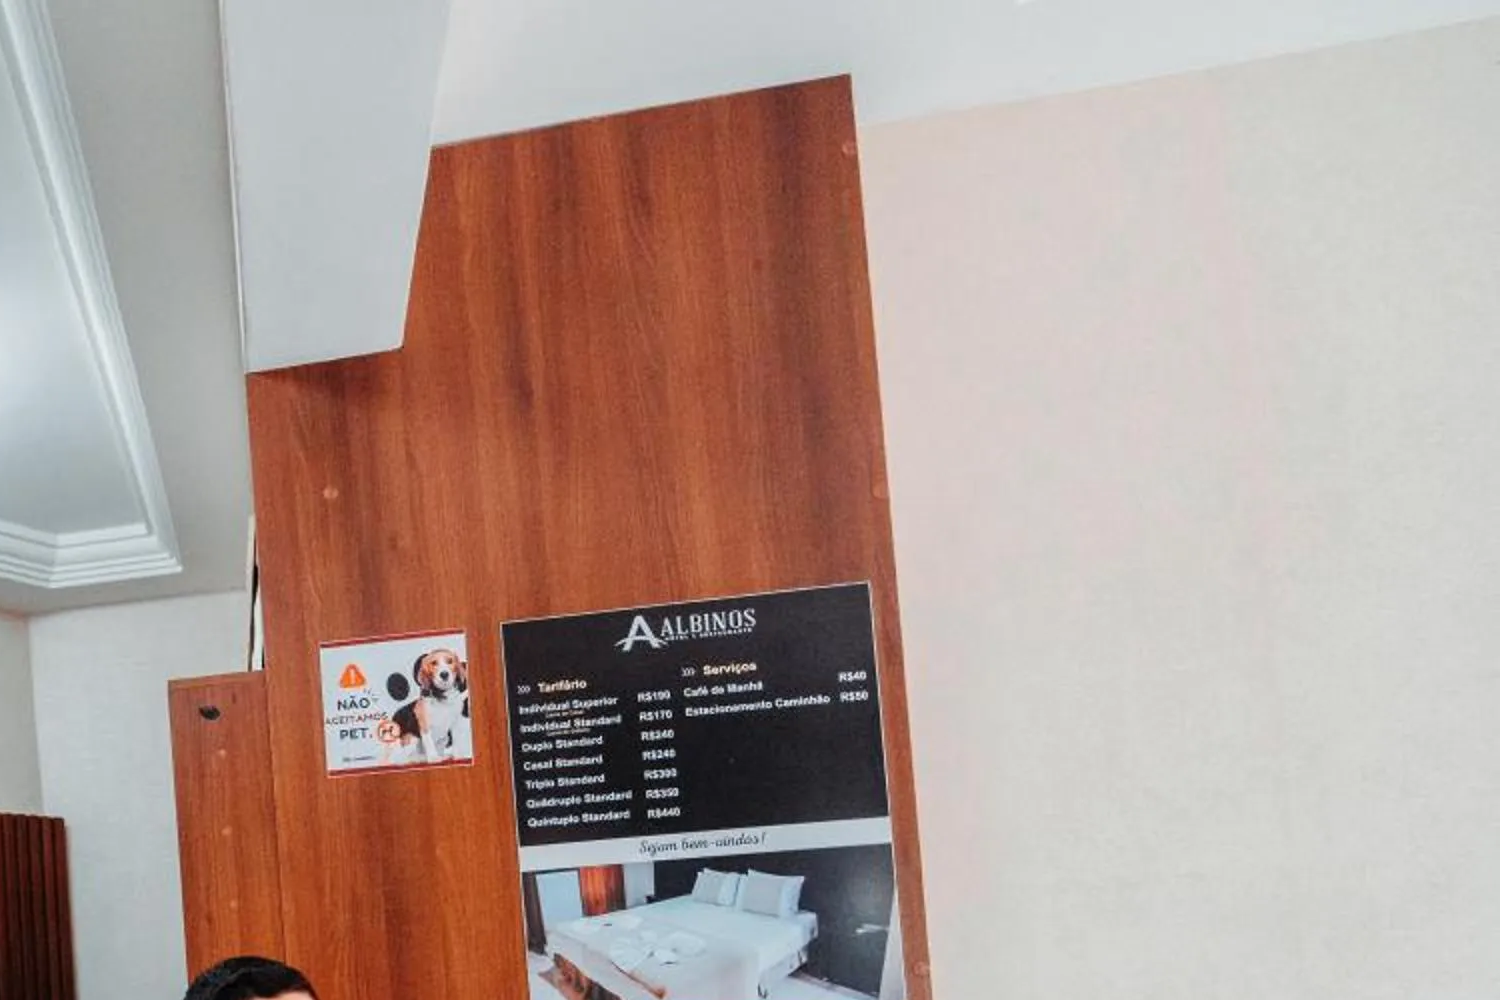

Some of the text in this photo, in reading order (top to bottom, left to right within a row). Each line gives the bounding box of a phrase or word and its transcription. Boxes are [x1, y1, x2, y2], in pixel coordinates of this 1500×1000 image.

[660, 607, 757, 637] ALBINOS
[702, 661, 758, 676] Serviços
[538, 679, 587, 693] Tarifário
[683, 684, 709, 698] Café
[838, 670, 867, 683] R$40
[337, 695, 372, 711] NÃO
[518, 700, 571, 715] Individual
[572, 696, 619, 711] Superior
[685, 700, 773, 717] Estacionamento
[775, 693, 831, 708] Caminhão
[326, 711, 389, 726] ACEITAMOS
[519, 718, 572, 734] Individual
[573, 713, 623, 728] Standard
[639, 709, 673, 723] R$170
[339, 727, 374, 740] PET.
[521, 740, 553, 753] Duplo
[555, 735, 603, 749] Standard
[523, 759, 553, 772] Casal
[555, 754, 603, 768] Standard
[557, 773, 605, 788] Standard
[583, 790, 633, 803] Standard
[581, 809, 631, 823] Standard
[639, 839, 678, 857] Sejam
